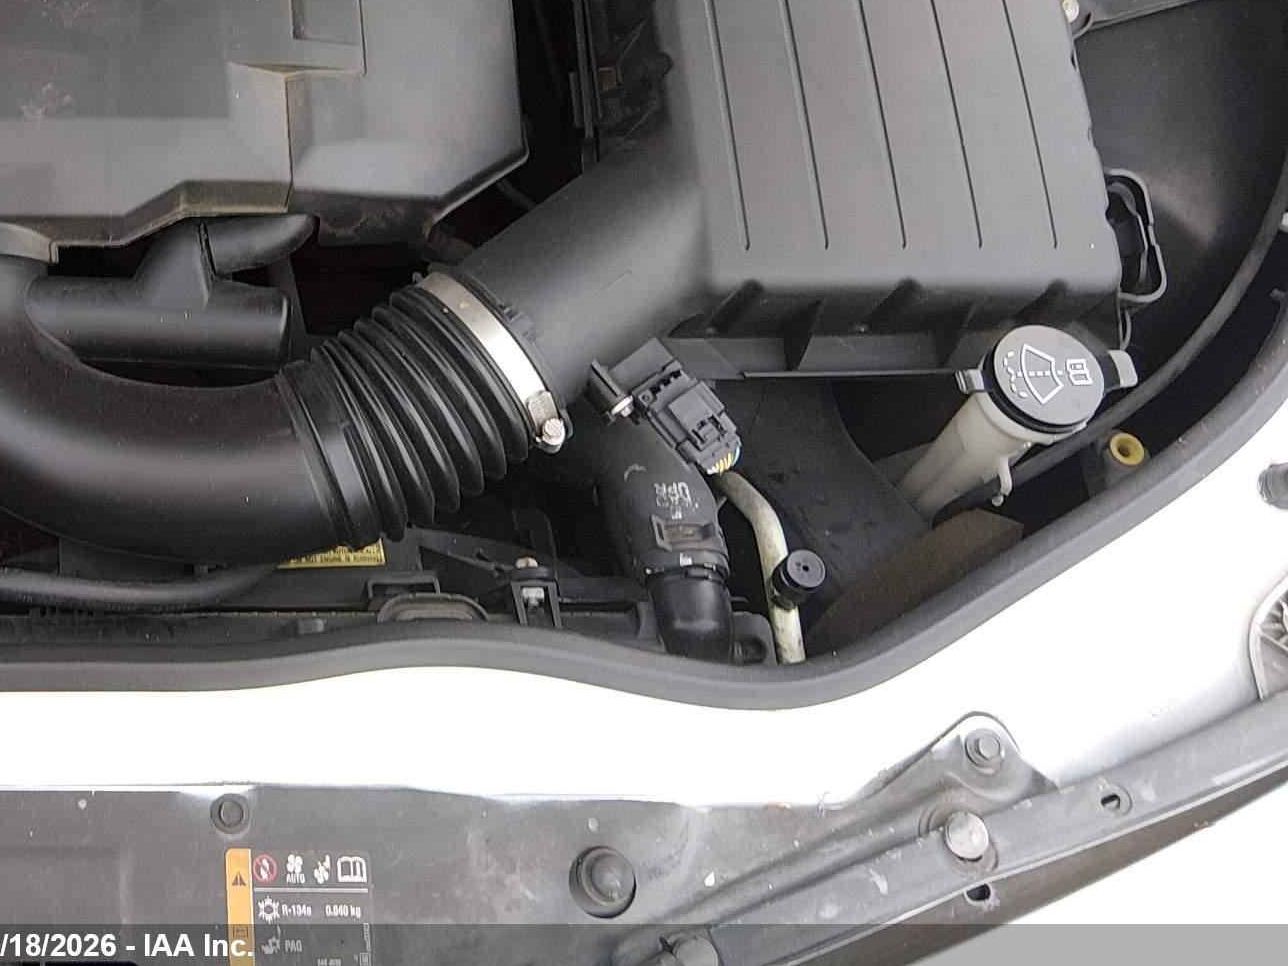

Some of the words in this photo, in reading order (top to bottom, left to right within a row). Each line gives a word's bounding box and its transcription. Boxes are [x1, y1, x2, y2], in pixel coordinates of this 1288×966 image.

[286, 873, 306, 884] AUTO
[282, 903, 312, 917] R-134a
[350, 904, 362, 919] kg
